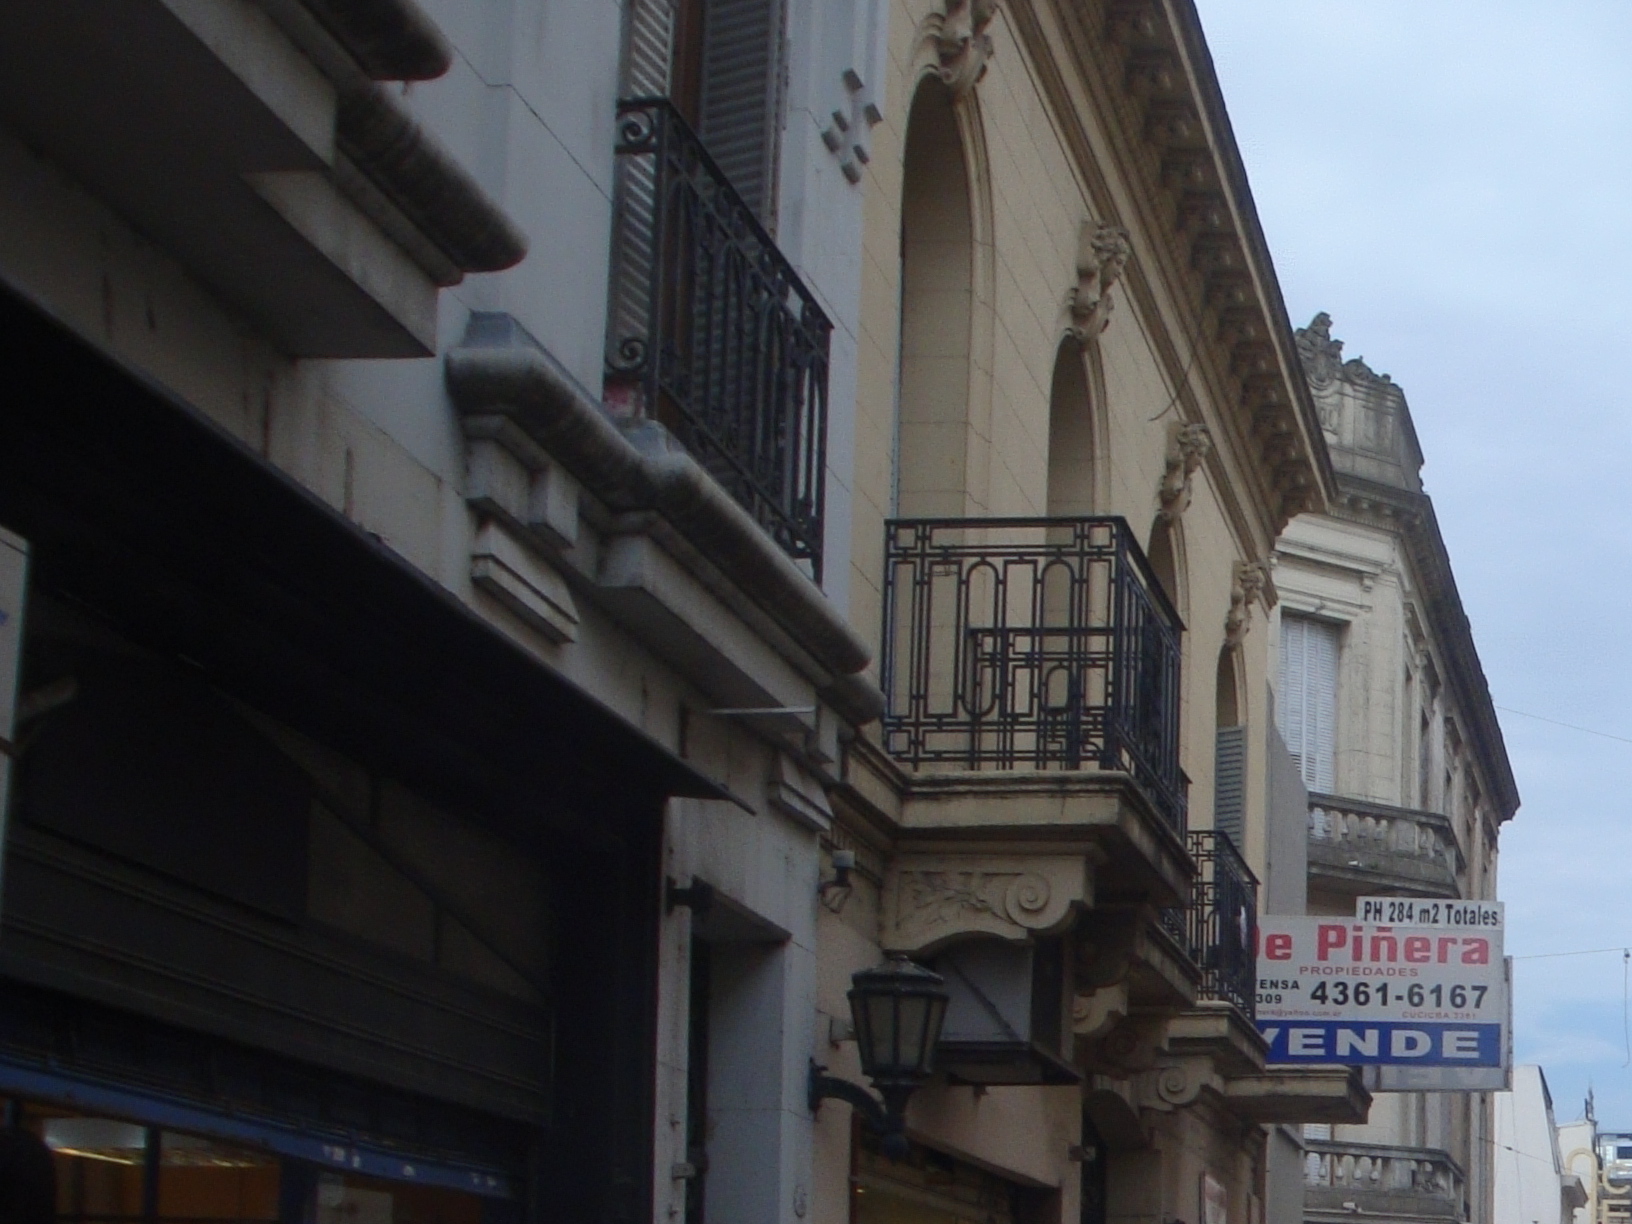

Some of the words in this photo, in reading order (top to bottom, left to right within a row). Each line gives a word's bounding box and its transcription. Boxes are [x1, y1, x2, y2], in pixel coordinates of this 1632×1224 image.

[1364, 901, 1382, 921] PH
[1388, 902, 1414, 922] 284
[1419, 903, 1440, 924] m2
[1445, 903, 1498, 926] Totales
[1254, 924, 1292, 961] e
[1317, 924, 1489, 964] Piñera
[1299, 966, 1418, 977] PROPIEDADES
[1256, 979, 1300, 990] ENSA
[1310, 980, 1488, 1009] 4361-6167
